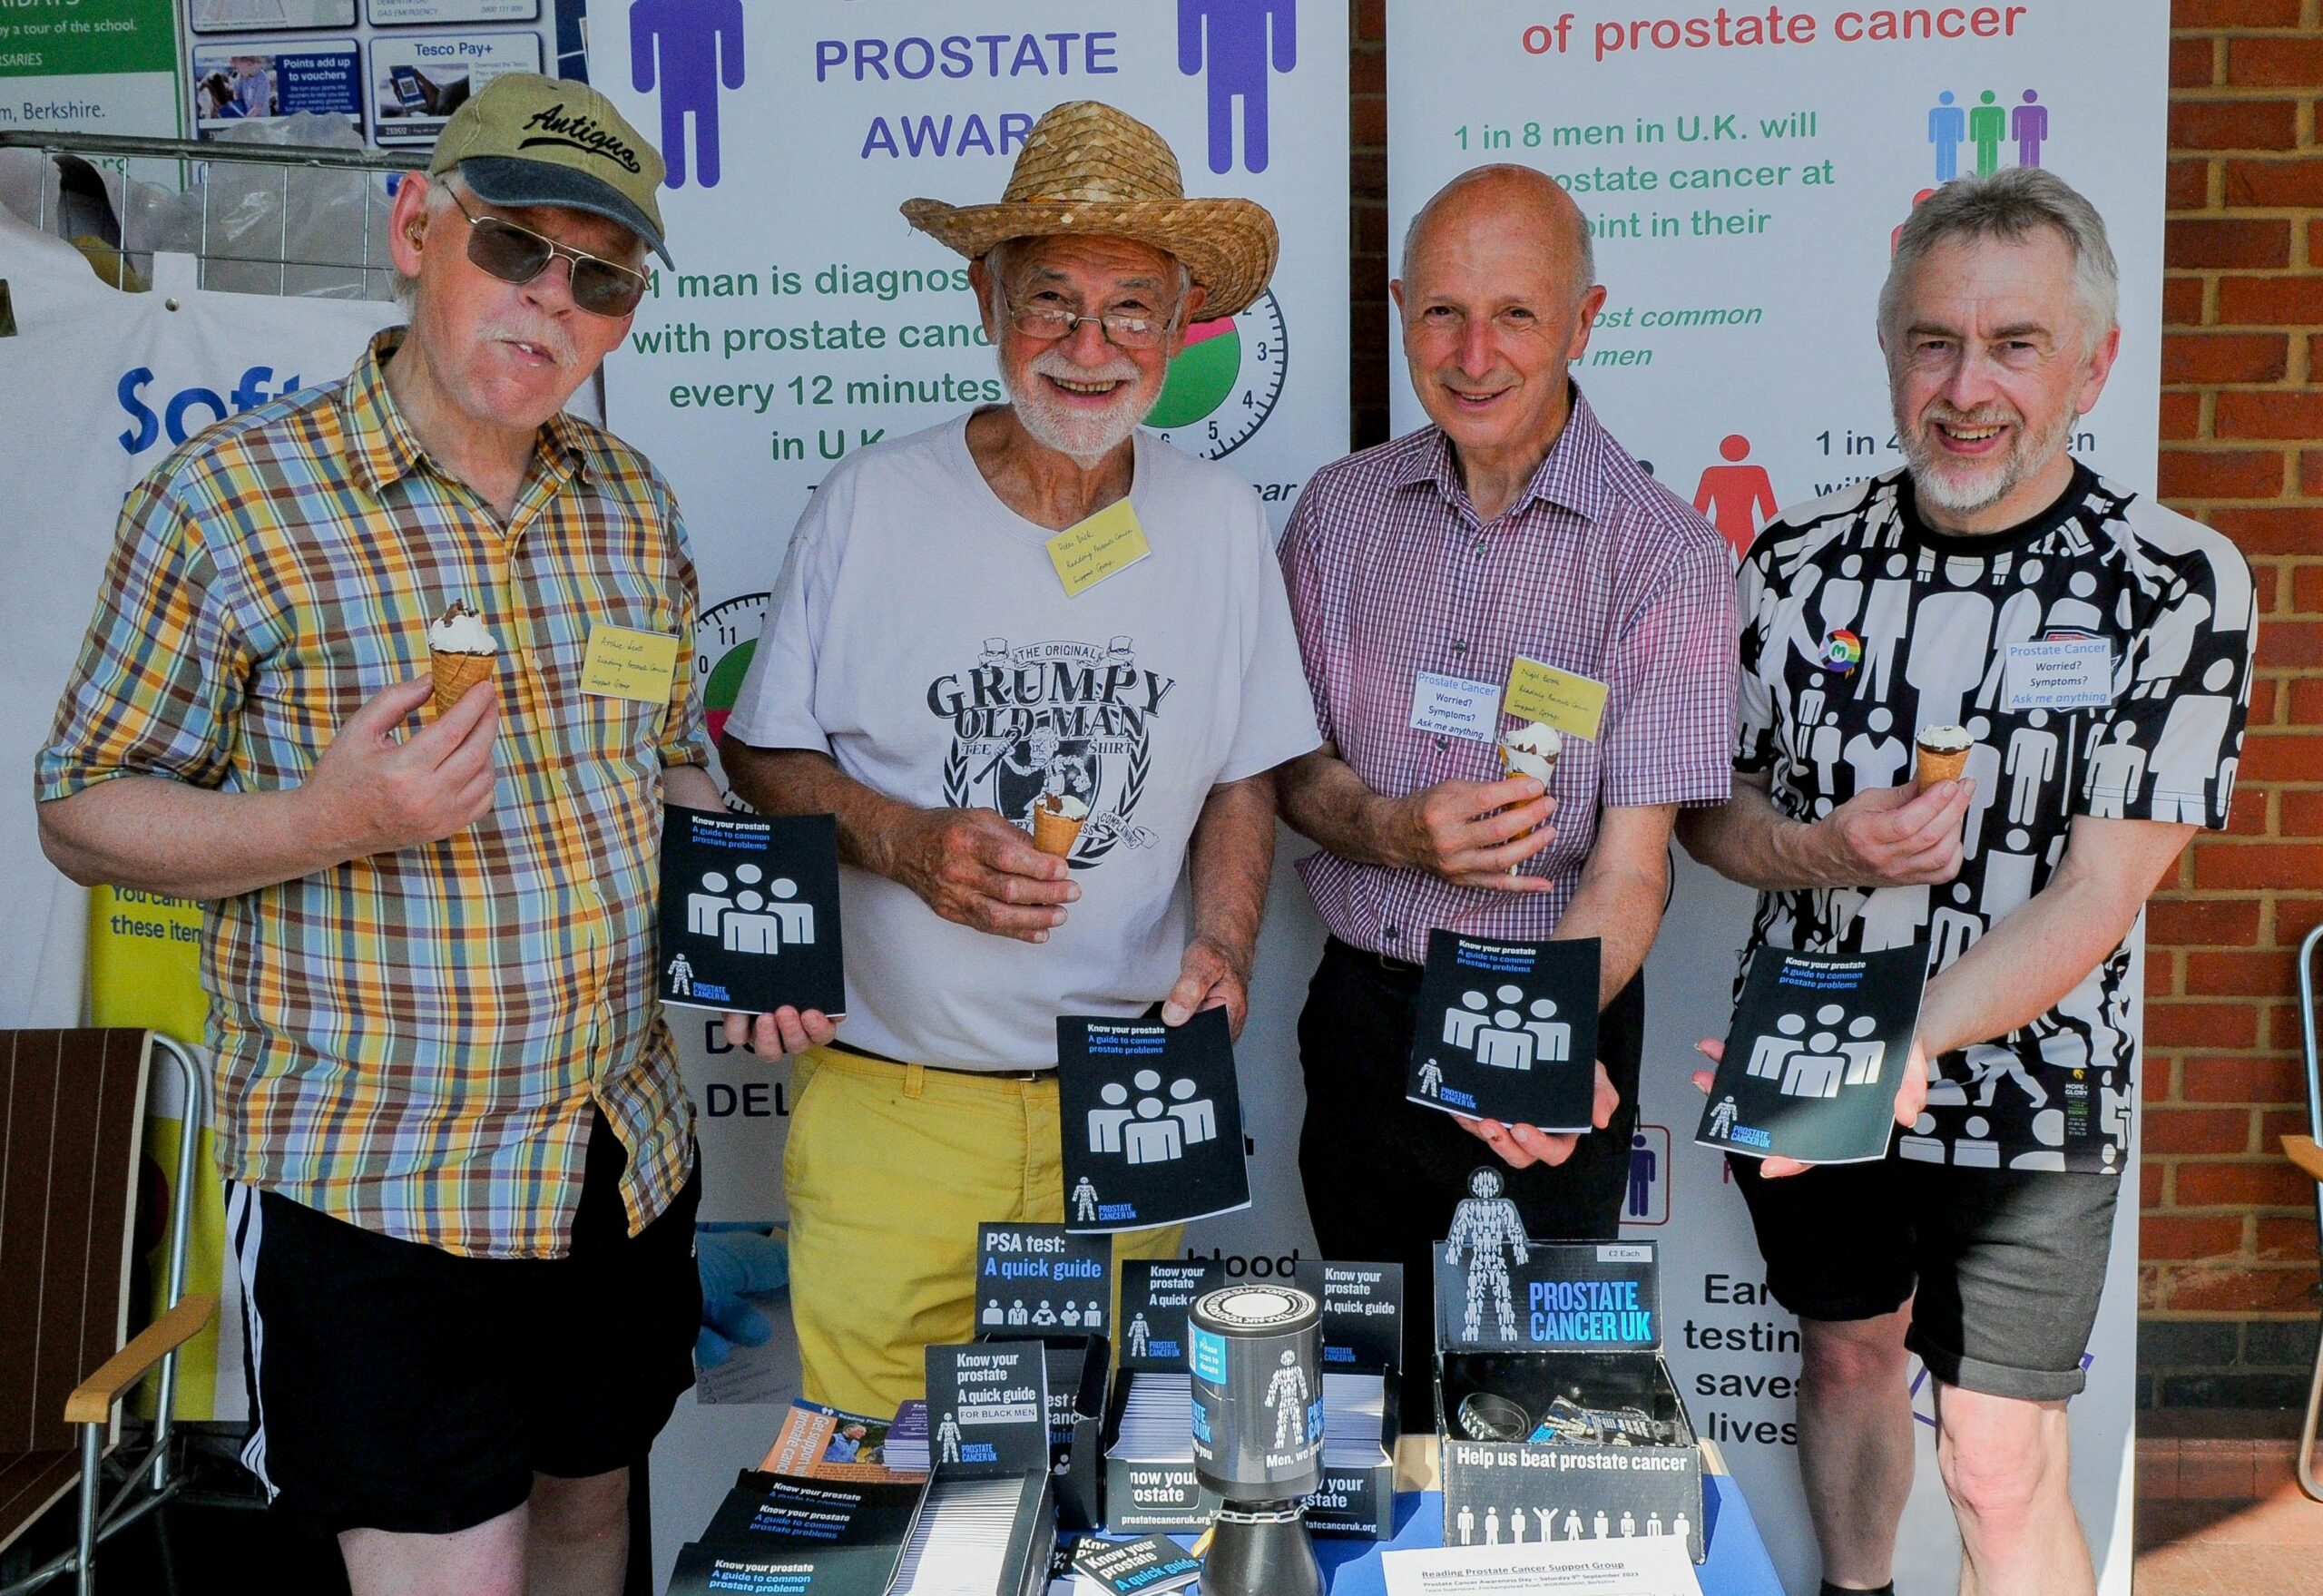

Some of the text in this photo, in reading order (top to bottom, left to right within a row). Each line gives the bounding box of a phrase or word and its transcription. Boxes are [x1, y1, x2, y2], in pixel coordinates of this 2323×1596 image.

[24, 24, 49, 34] tour
[54, 20, 67, 33] of
[70, 21, 91, 33] the
[94, 18, 138, 33] school.
[1522, 4, 2027, 63] of prostate cancer
[415, 42, 493, 57] Tesco Pay+
[816, 32, 1118, 82] PROSTATE
[0, 53, 43, 66] SARIES
[283, 57, 351, 69] Points add up
[289, 71, 347, 82] to vouchers
[24, 101, 106, 120] Berkshire.
[523, 103, 641, 169] Antigua
[861, 112, 1032, 159] AWAR
[1455, 111, 1817, 151] 1 in 8 men in U.K. will
[1549, 159, 1836, 193] ostate cancer at
[1652, 208, 1772, 237] in their
[647, 269, 660, 298] 1
[678, 273, 758, 298] man
[771, 265, 802, 296] is
[1641, 307, 1763, 328] common
[632, 322, 711, 355] with
[725, 319, 886, 359] prostate
[1258, 342, 1268, 361] 3
[1593, 348, 1653, 366] men
[670, 373, 1002, 414] every 12 minutes
[1242, 390, 1253, 409] 4
[1209, 421, 1218, 439] 5
[771, 430, 804, 461] in
[1816, 429, 1875, 455] 1 in
[719, 626, 736, 645] 11
[1016, 643, 1097, 661] THE ORIGINAL
[2010, 642, 2106, 657] Prostate Cancer
[2035, 661, 2083, 671] Worried?
[926, 661, 1176, 719] GRUMPY
[1417, 671, 1496, 697] Prostate Cancer
[2030, 675, 2088, 689] Symptoms?
[1436, 692, 1473, 707] Worried?
[2012, 692, 2107, 705] Ask me anything
[1428, 705, 1476, 722] Symptoms?
[954, 706, 1149, 742] OLD MAN
[1416, 718, 1485, 740] Ask me anything
[962, 741, 1134, 756] TEE SHIRT
[691, 816, 770, 831] Know your prostate
[1100, 812, 1138, 847] COMPLAINING
[692, 835, 767, 850] prostate problems
[700, 827, 722, 837] guide
[735, 832, 770, 841] common
[111, 915, 164, 939] these
[1087, 1023, 1165, 1034] Know your prostate
[1088, 1034, 1095, 1043] A
[1096, 1035, 1119, 1044] guide
[1089, 1045, 1163, 1055] prostate problems
[706, 1082, 789, 1118] DEL
[985, 1232, 1065, 1253] PSA test:
[1621, 1249, 1640, 1258] Each
[985, 1257, 1102, 1281] A quick guide
[1151, 1266, 1205, 1279] Know your
[1150, 1278, 1194, 1290] prostate
[1149, 1293, 1187, 1307] A quick
[1529, 1281, 1639, 1311] PROSTATE
[1530, 1311, 1652, 1342] CANCER UK
[1683, 1319, 1800, 1354] testin
[956, 1353, 1019, 1368] Know your
[956, 1367, 1007, 1385] prostate
[1695, 1373, 1799, 1399] save
[958, 1386, 1036, 1405] A quick guide
[982, 1409, 1012, 1417] BLACK
[1014, 1408, 1034, 1416] MEN
[1709, 1411, 1798, 1445] lives
[961, 1444, 993, 1453] PROSTATE
[1200, 1445, 1212, 1461] you
[962, 1453, 987, 1463] CANCER
[1266, 1454, 1294, 1468] Men,
[1457, 1446, 1688, 1472] Help us beat prostate cancer
[1328, 1478, 1364, 1494] your
[1121, 1514, 1211, 1526] prostatecanceruk.org
[1084, 1547, 1127, 1570] Know
[1124, 1540, 1157, 1555] your
[714, 1560, 814, 1573] Know your prostate
[1099, 1552, 1158, 1581] prostate
[1114, 1559, 1200, 1591] A quick guide
[1422, 1561, 1624, 1579] Reading Prostate Cancer Support Group
